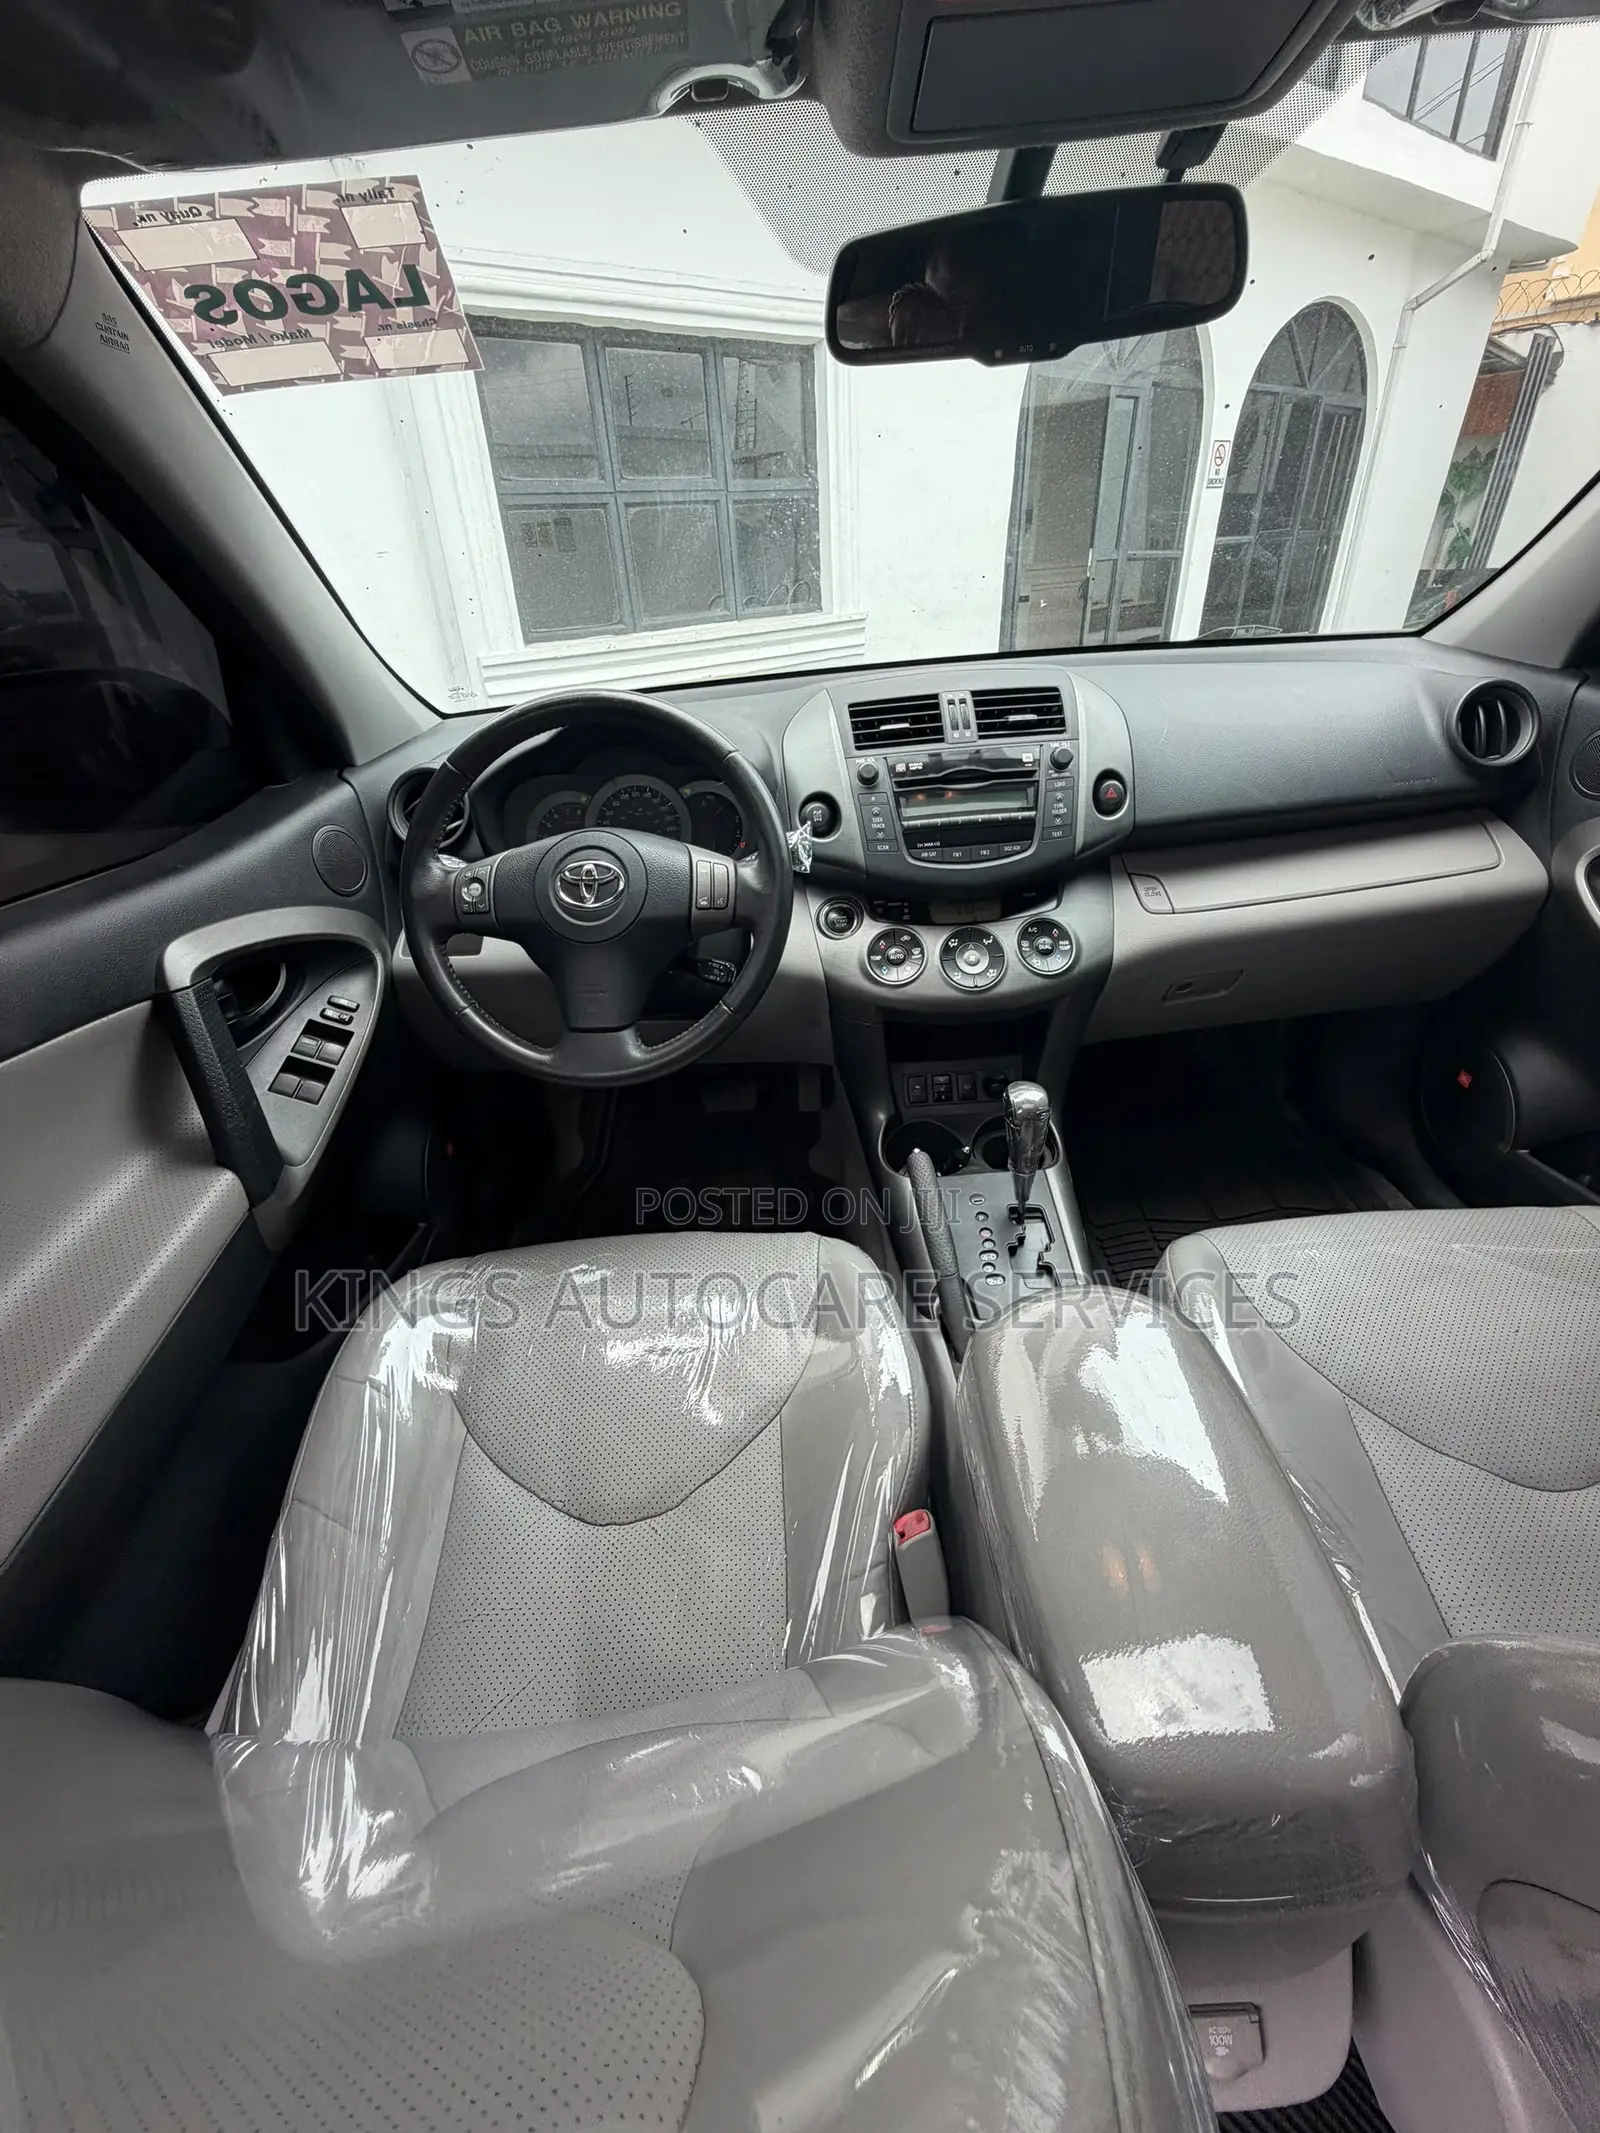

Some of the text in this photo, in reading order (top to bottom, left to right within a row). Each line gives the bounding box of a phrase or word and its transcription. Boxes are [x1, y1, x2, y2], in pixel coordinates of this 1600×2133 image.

[464, 25, 502, 44] AIR
[510, 17, 562, 38] BAG
[570, 1, 682, 29] WARNING
[889, 953, 904, 961] AUTO
[1208, 2034, 1233, 2047] 100W
